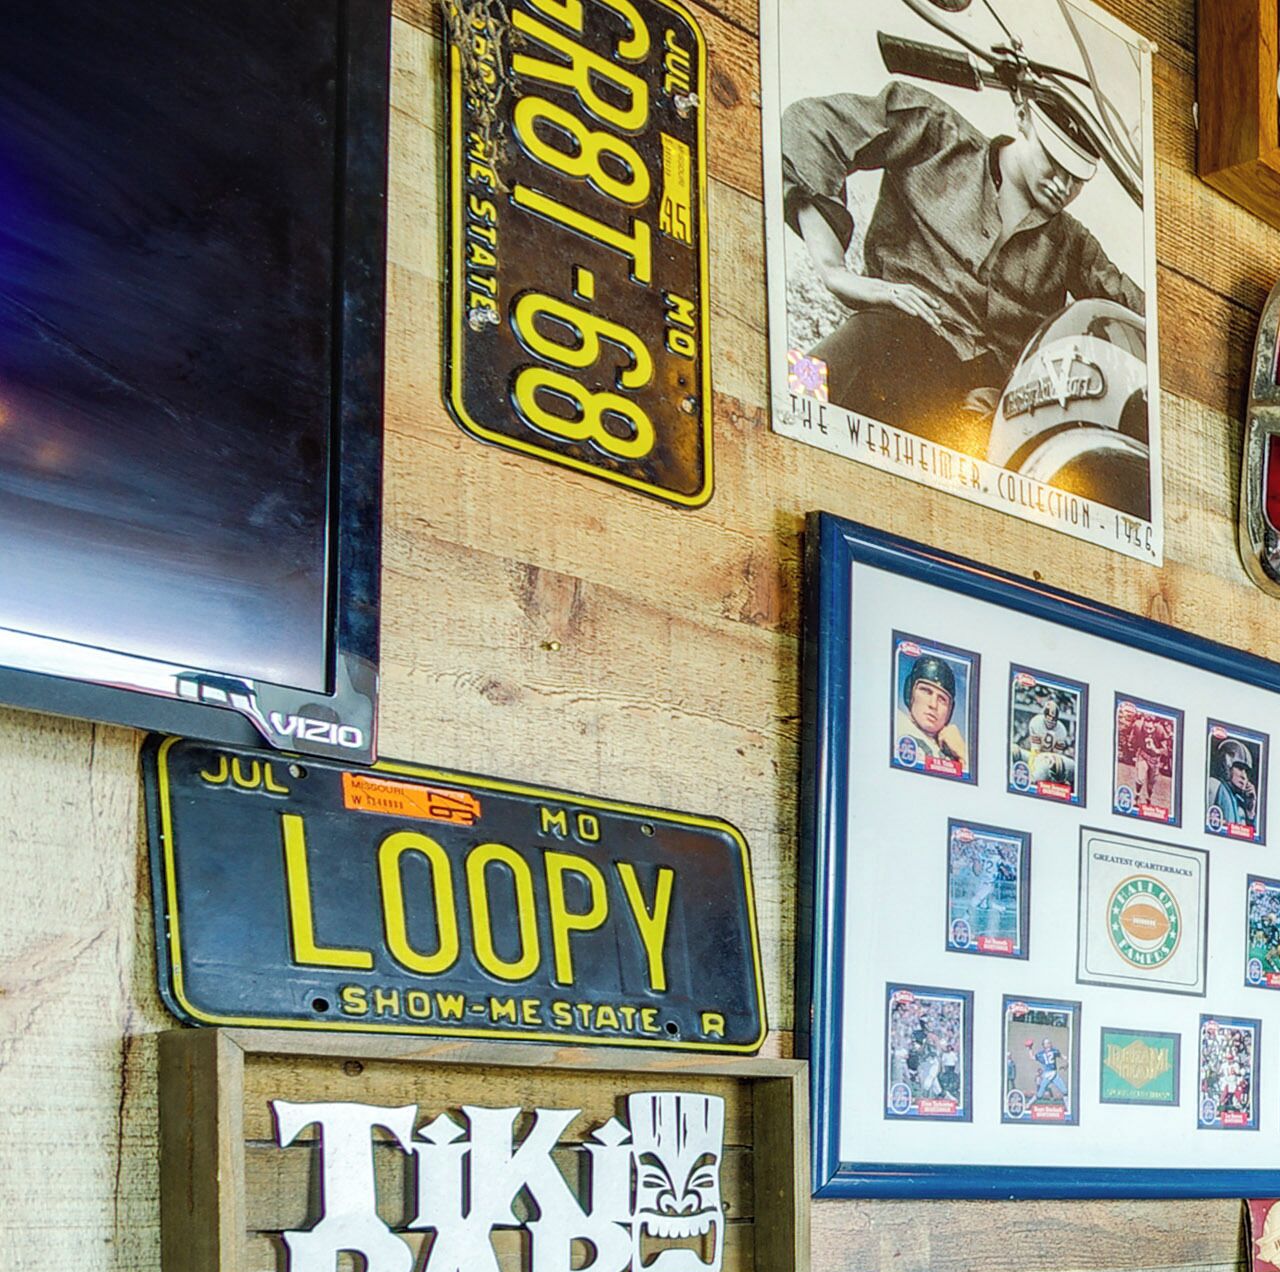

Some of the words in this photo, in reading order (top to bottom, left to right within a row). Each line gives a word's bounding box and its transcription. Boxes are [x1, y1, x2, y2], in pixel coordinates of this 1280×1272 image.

[665, 29, 690, 92] JUL
[666, 293, 696, 358] MO
[789, 394, 828, 435] THE
[848, 409, 983, 494] WERTHEIMER
[998, 473, 1092, 528] COLLECTION
[268, 712, 363, 749] VIZIO
[200, 754, 291, 796] JUL
[541, 806, 601, 843] MO
[1092, 852, 1134, 867] GREATEST
[1134, 860, 1194, 878] QUARTERBACKS
[281, 813, 674, 992] LOOPY
[338, 985, 544, 1026] SHOW-ME
[554, 1000, 661, 1035] STATE
